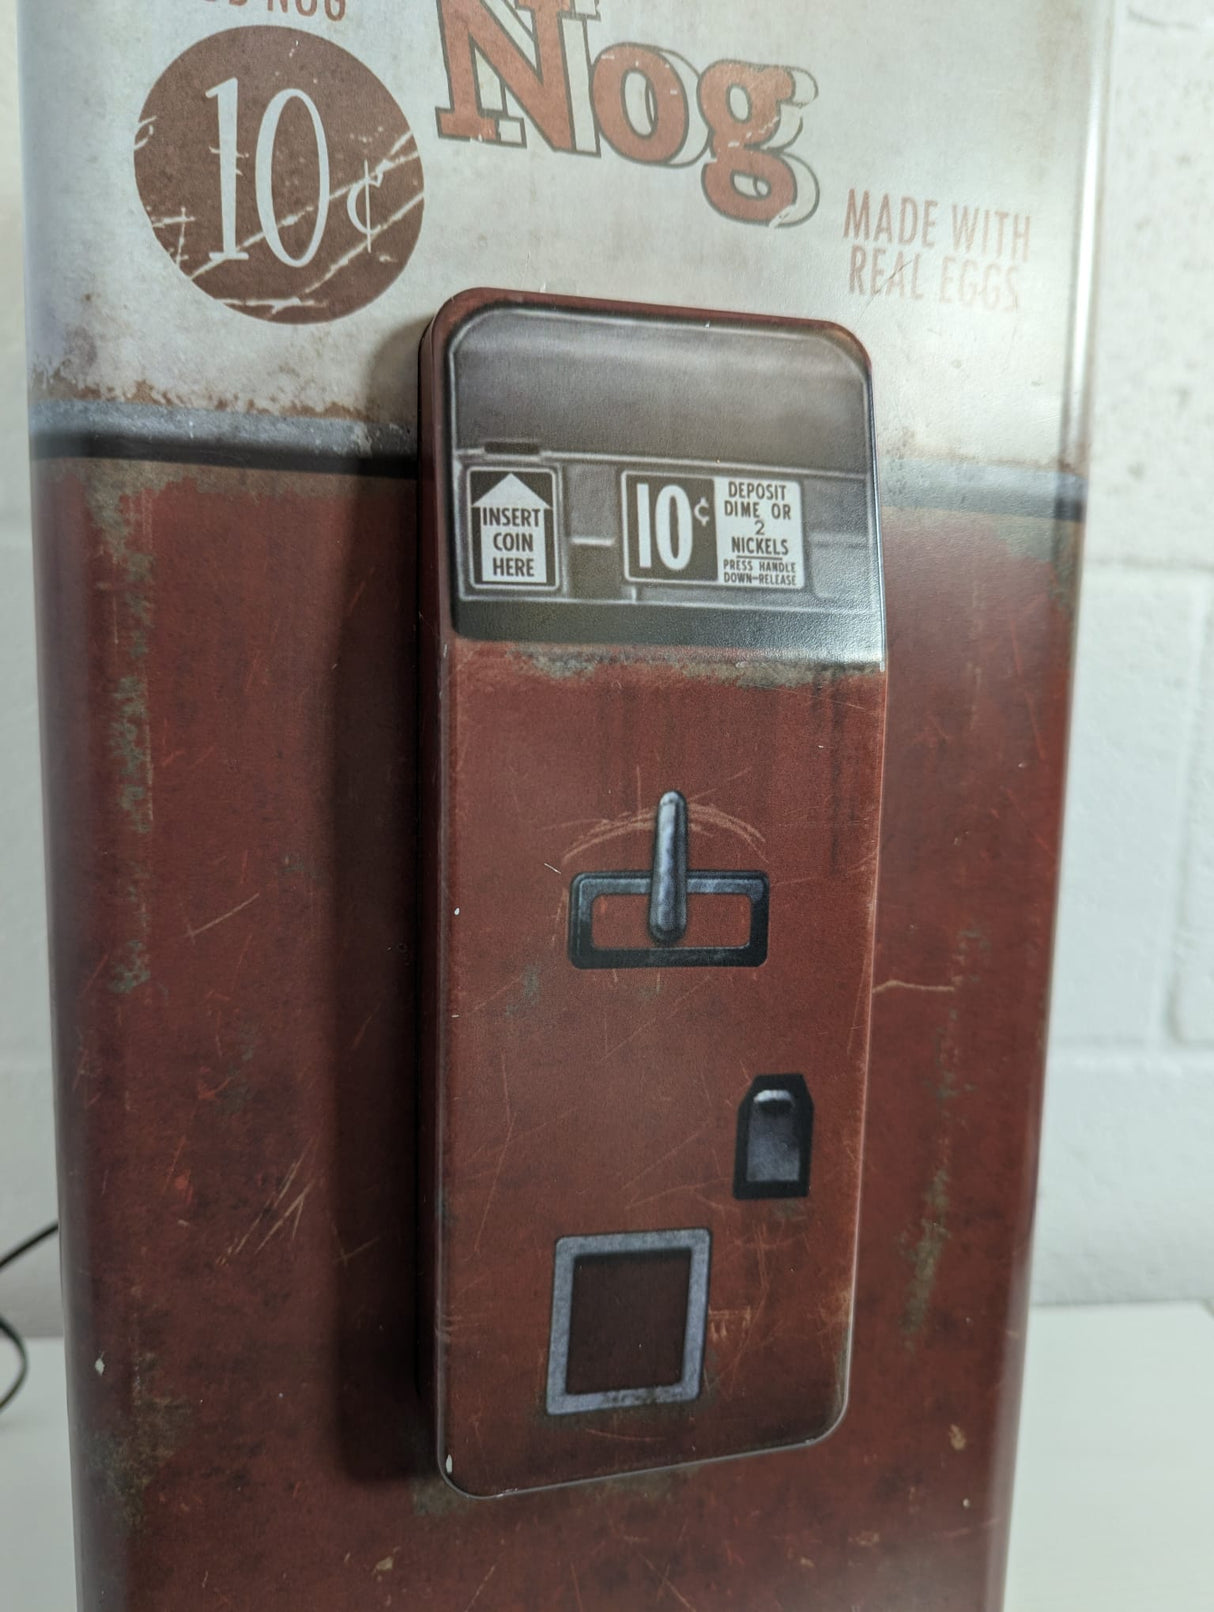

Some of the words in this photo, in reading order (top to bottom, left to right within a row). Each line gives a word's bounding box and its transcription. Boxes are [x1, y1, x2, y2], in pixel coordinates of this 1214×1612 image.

[435, 0, 820, 228] Nog
[843, 187, 938, 249] MADE
[951, 203, 1031, 264] WITH
[849, 244, 924, 300] REAL
[939, 256, 1021, 313] EGGS
[728, 481, 787, 501] DEPOSIT
[482, 506, 541, 528] INSERT
[724, 500, 760, 518] DIME
[771, 503, 791, 520] OR
[754, 520, 765, 536] 2
[493, 532, 534, 553] COIN
[731, 536, 789, 556] NICKELS
[492, 556, 535, 577] HERE
[723, 559, 753, 572] PRESS
[759, 561, 796, 573] HANDLE
